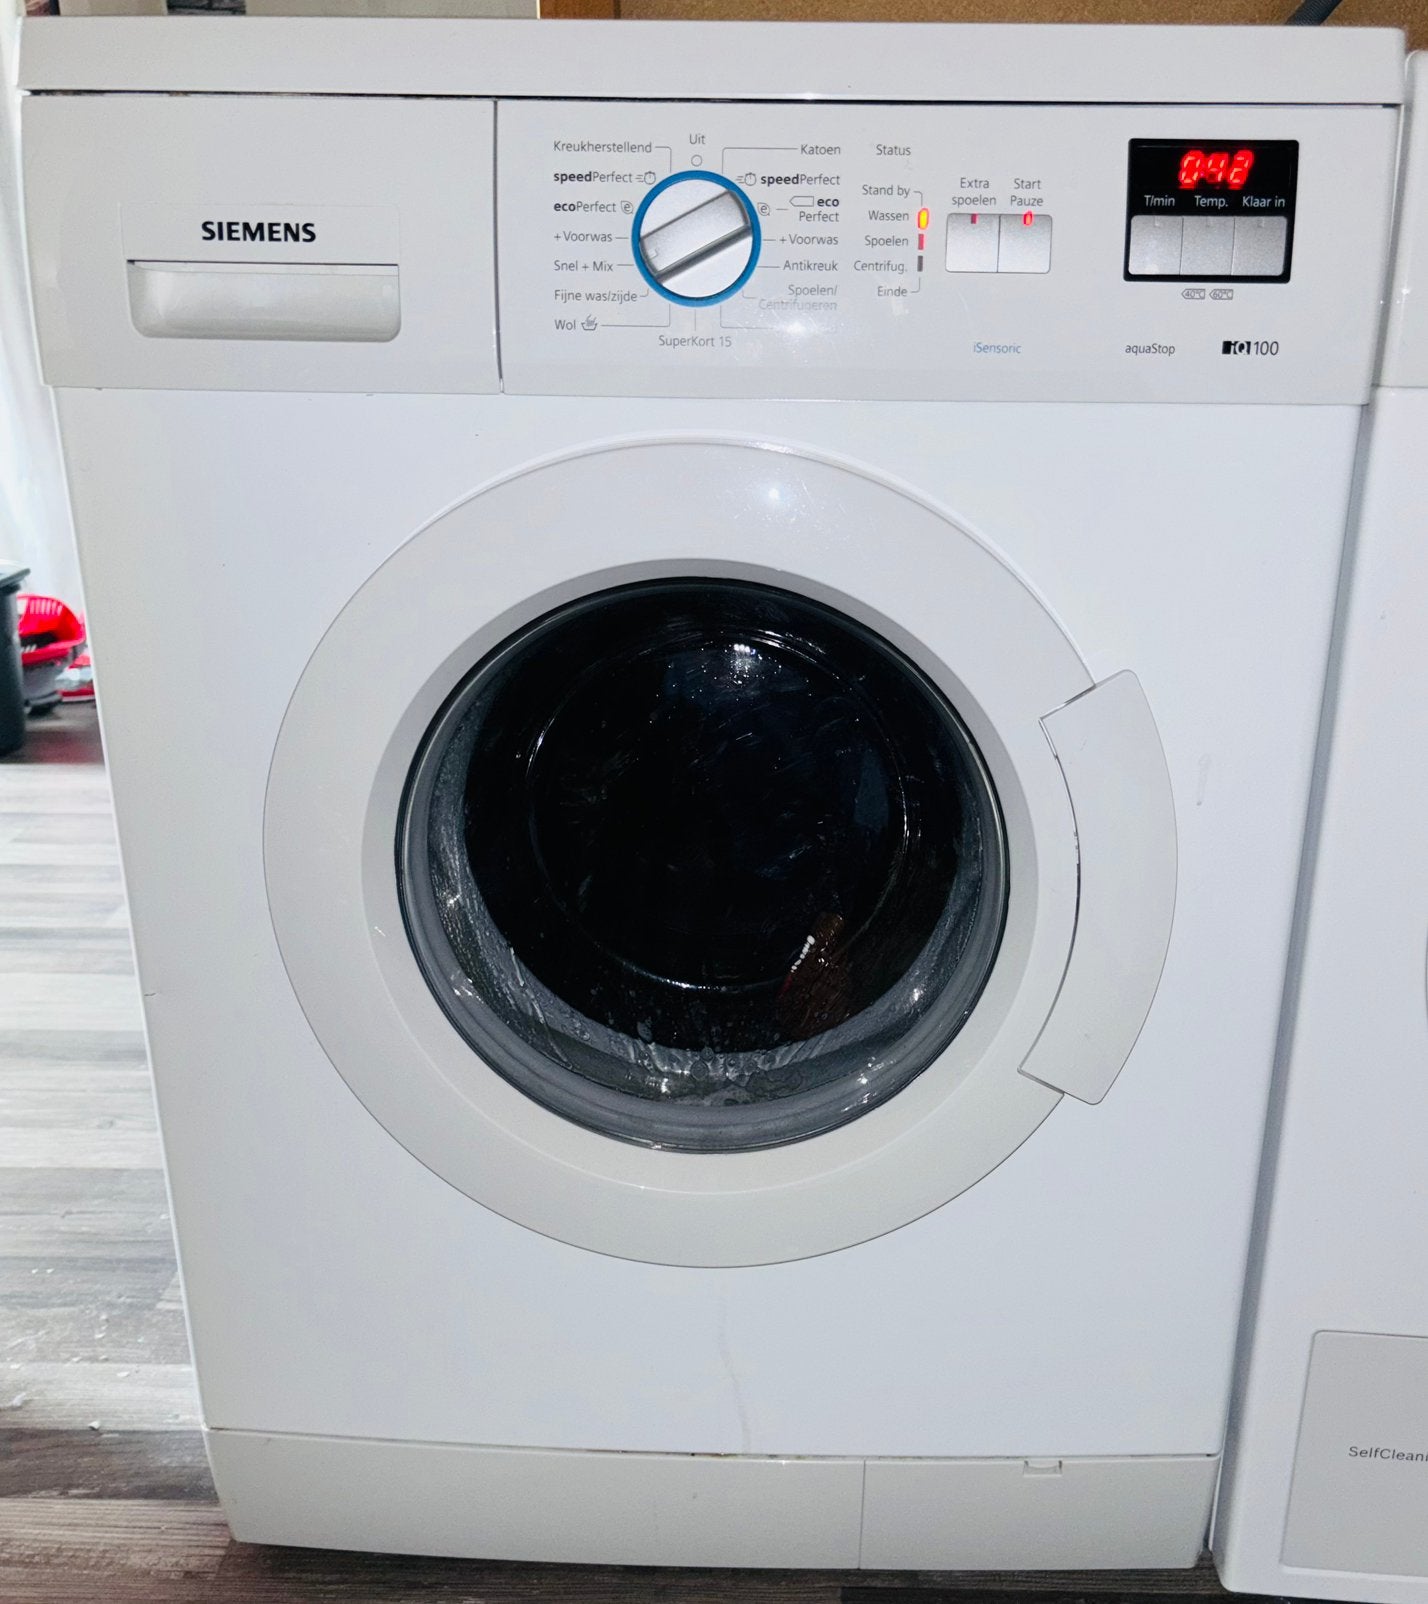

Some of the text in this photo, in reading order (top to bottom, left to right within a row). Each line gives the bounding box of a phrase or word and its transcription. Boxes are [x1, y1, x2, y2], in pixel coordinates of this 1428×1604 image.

[689, 134, 706, 145] Uit
[553, 141, 652, 153] Kreukherstellend
[800, 144, 841, 155] Katoen
[875, 144, 911, 156] Status
[553, 171, 633, 184] speedPerfect
[760, 173, 841, 186] speedPerfect
[960, 178, 990, 189] Extra
[1014, 178, 1042, 190] Start
[862, 184, 910, 199] Stand by
[816, 198, 840, 207] eco
[951, 194, 997, 208] spoelen
[1010, 195, 1044, 207] Pauze
[1144, 195, 1176, 206] T/min
[1194, 195, 1229, 208] Temp.
[1242, 196, 1286, 207] Klaar in
[553, 201, 617, 213] ecoPerfect
[799, 211, 840, 222] Perfect
[868, 210, 910, 221] Wassen
[201, 220, 316, 243] SIEMENS
[563, 231, 613, 242] Voorwas
[788, 234, 839, 245] Voorwas
[864, 235, 909, 249] Spoelen
[553, 260, 578, 272] Snel
[592, 261, 613, 272] Mix
[783, 260, 839, 271] Antikreuk
[853, 260, 908, 275] Centrifug.
[788, 284, 838, 297] Spoelen/
[877, 286, 908, 297] Einde
[554, 289, 638, 305] Fijne was/zijde
[554, 319, 577, 331] Wol
[658, 335, 732, 349] SuperKort 15
[973, 342, 1022, 354] iSensoric
[1125, 343, 1175, 357] aquaStop
